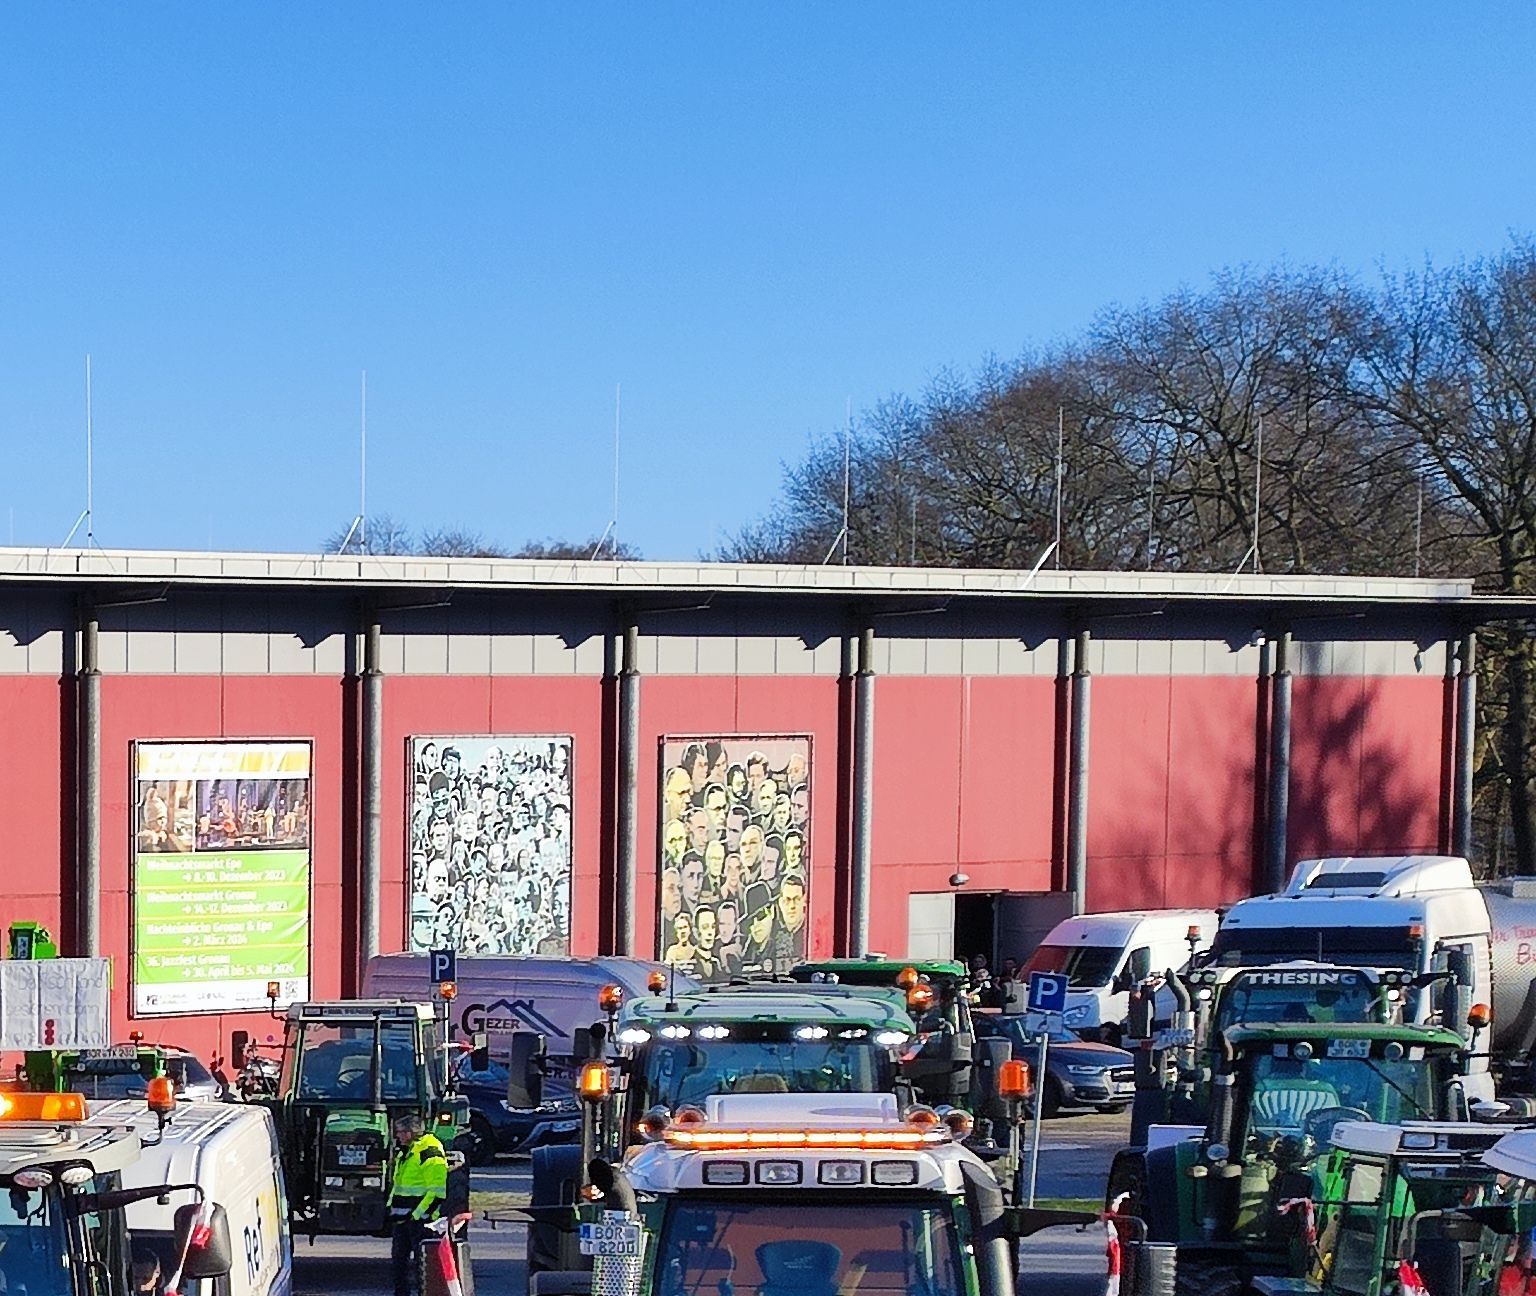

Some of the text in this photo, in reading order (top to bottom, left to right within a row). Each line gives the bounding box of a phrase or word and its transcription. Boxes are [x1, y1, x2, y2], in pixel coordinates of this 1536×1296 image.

[435, 954, 450, 980] P
[1247, 973, 1357, 986] THESING
[1036, 977, 1059, 1004] P
[461, 1003, 521, 1036] GEZER
[594, 1226, 624, 1240] BOR
